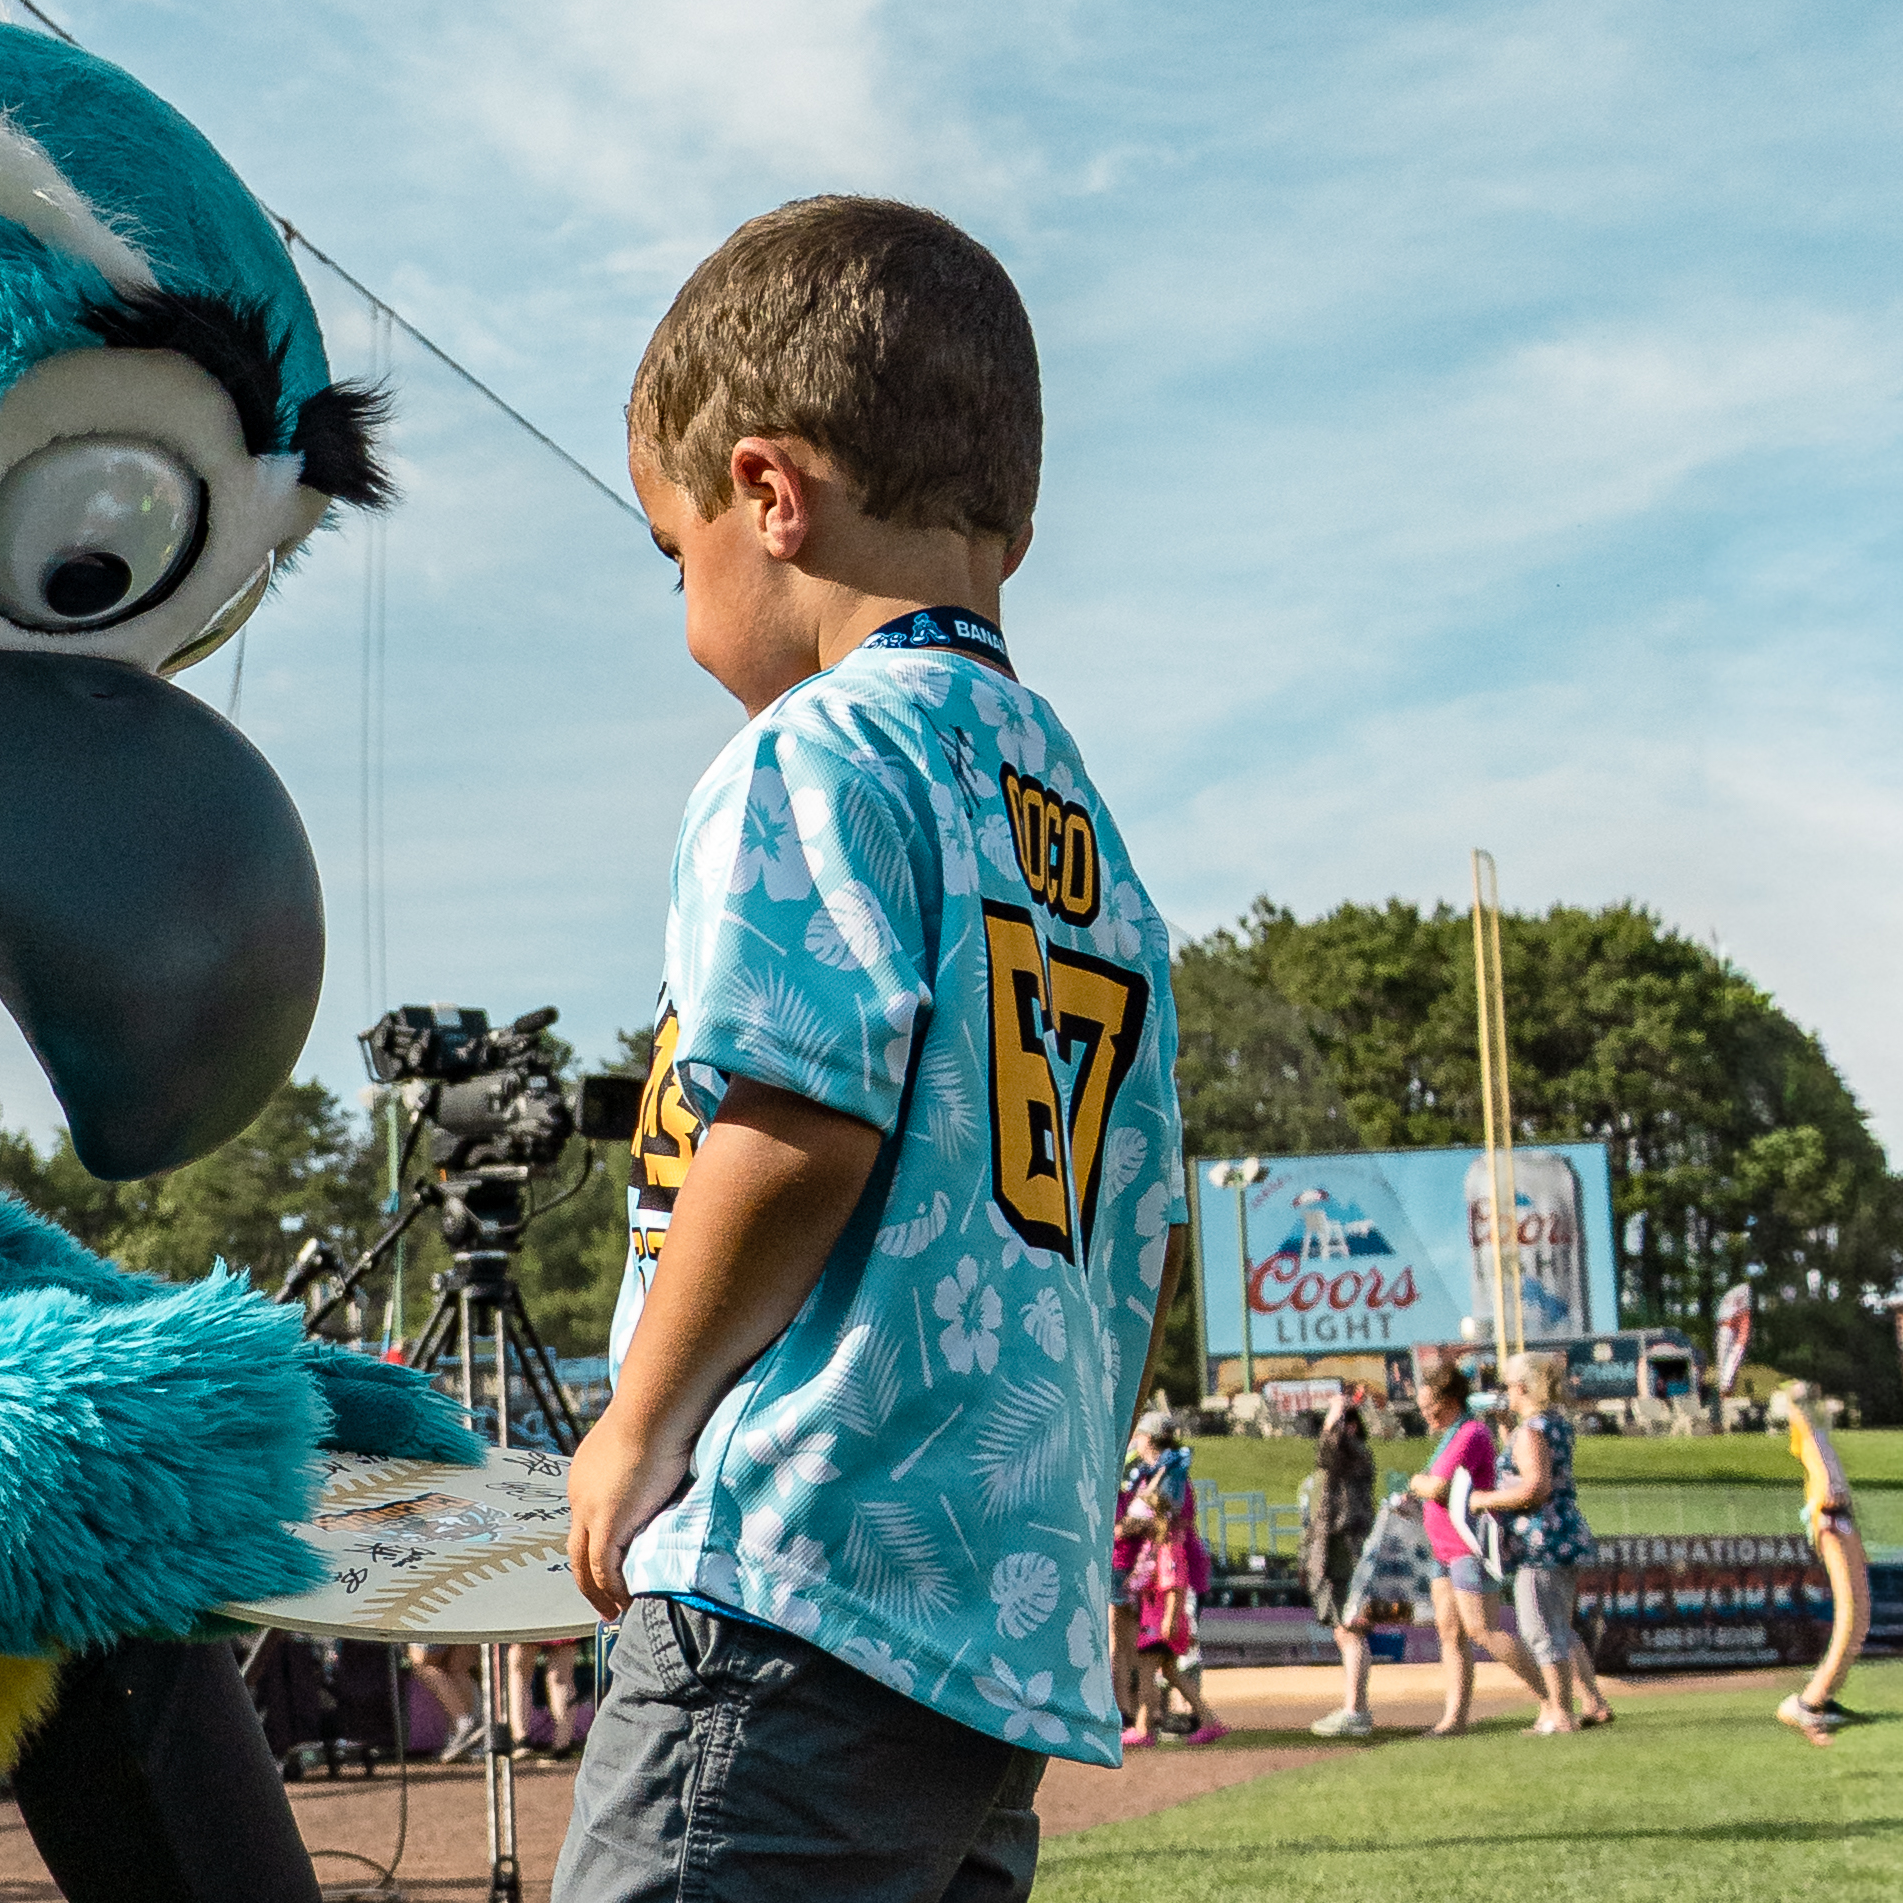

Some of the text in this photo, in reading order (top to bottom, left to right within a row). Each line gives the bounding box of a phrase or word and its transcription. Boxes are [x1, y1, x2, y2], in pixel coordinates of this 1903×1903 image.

[953, 619, 1006, 655] BANA
[981, 897, 1150, 1278] 67
[1248, 1250, 1419, 1315] Coors
[1276, 1313, 1393, 1344] LIGHT
[1597, 1536, 1811, 1567] NTERNATIONAL
